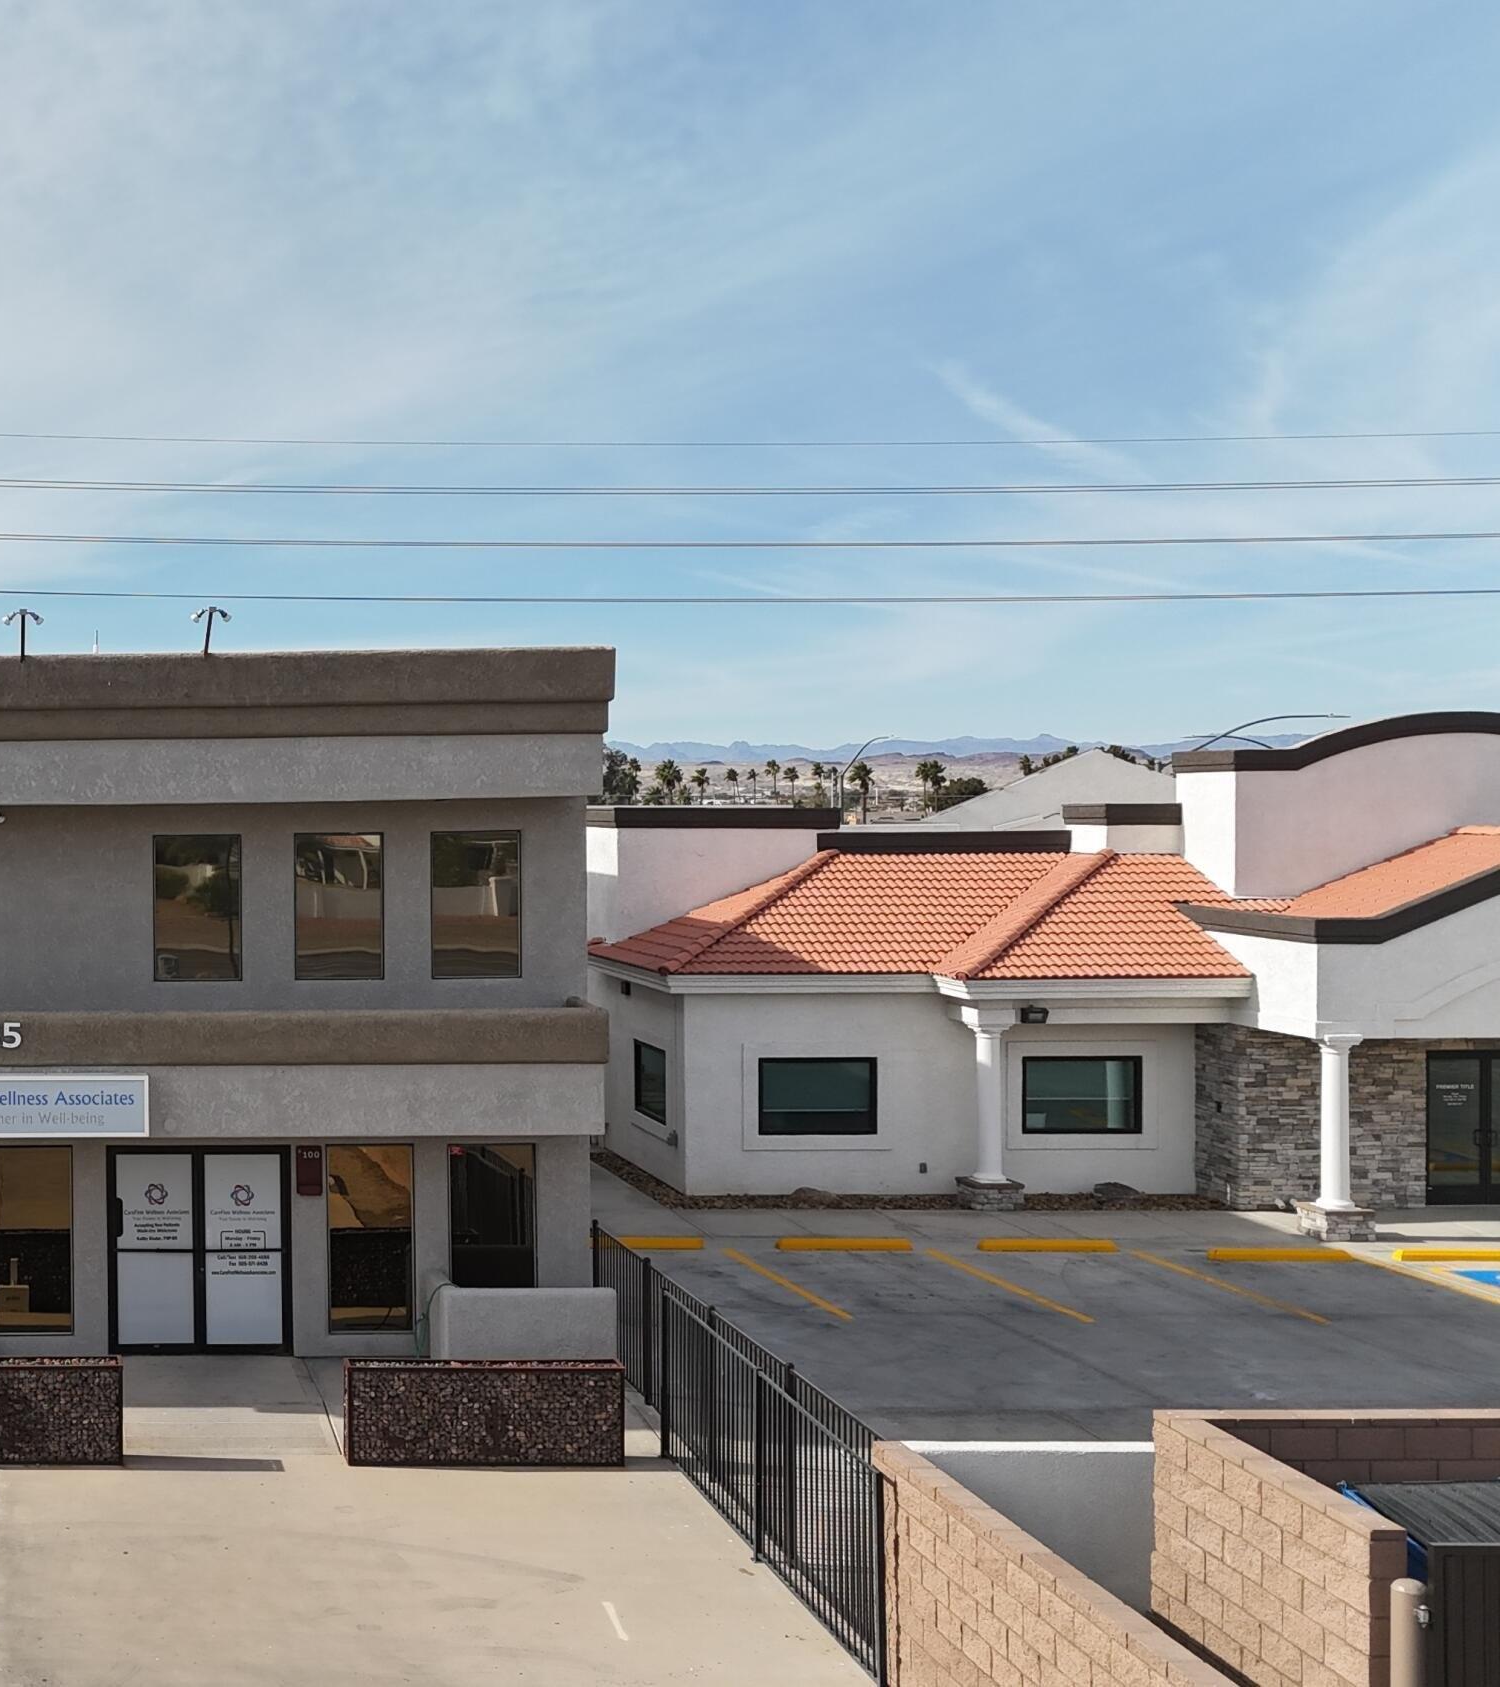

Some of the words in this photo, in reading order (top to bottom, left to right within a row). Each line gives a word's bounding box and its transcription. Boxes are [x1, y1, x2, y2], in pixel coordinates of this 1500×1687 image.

[54, 1090, 135, 1105] Associates
[22, 1112, 33, 1124] in
[37, 1112, 105, 1126] Well-being
